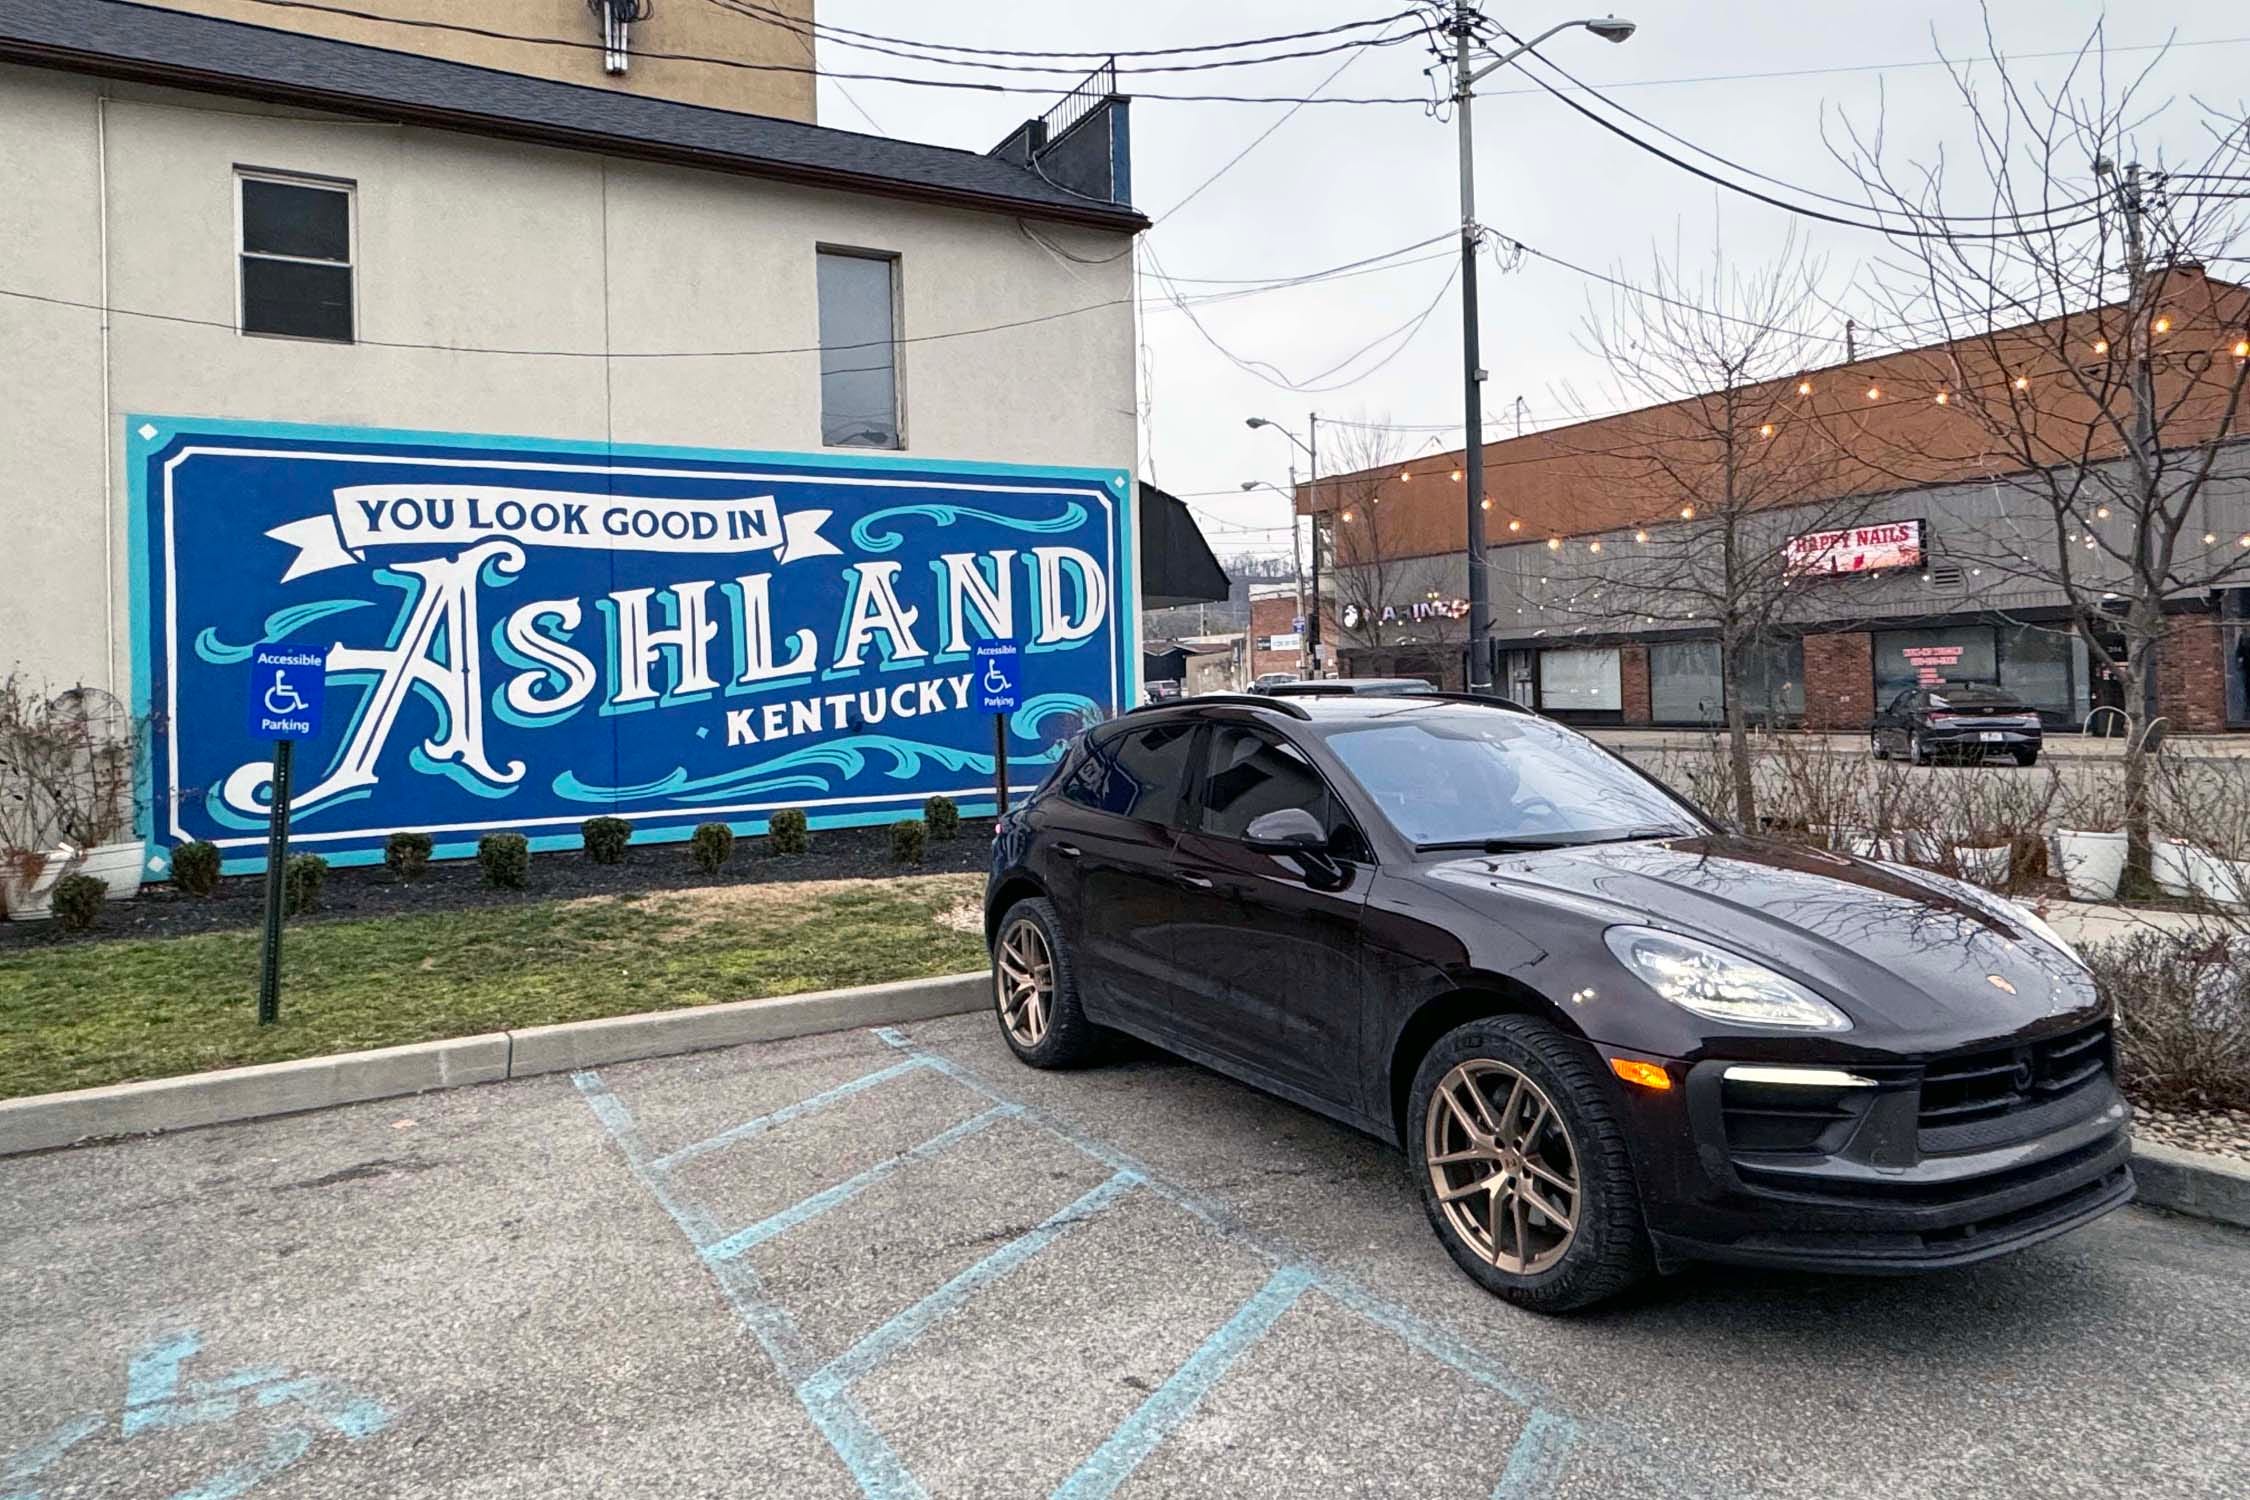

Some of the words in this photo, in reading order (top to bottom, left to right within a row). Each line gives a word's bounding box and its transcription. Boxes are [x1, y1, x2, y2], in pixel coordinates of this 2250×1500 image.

[356, 498, 454, 532] YOU
[468, 499, 590, 535] LOOK
[602, 506, 719, 540] GOOD
[727, 509, 768, 541] IN
[1856, 524, 1910, 546] NAILS
[257, 653, 322, 667] Accessible
[977, 645, 1017, 656] Accessible
[223, 539, 1107, 814] ASHLAND
[726, 672, 975, 747] KENTUCKY
[984, 696, 1014, 707] Parking
[262, 718, 310, 734] Parking
